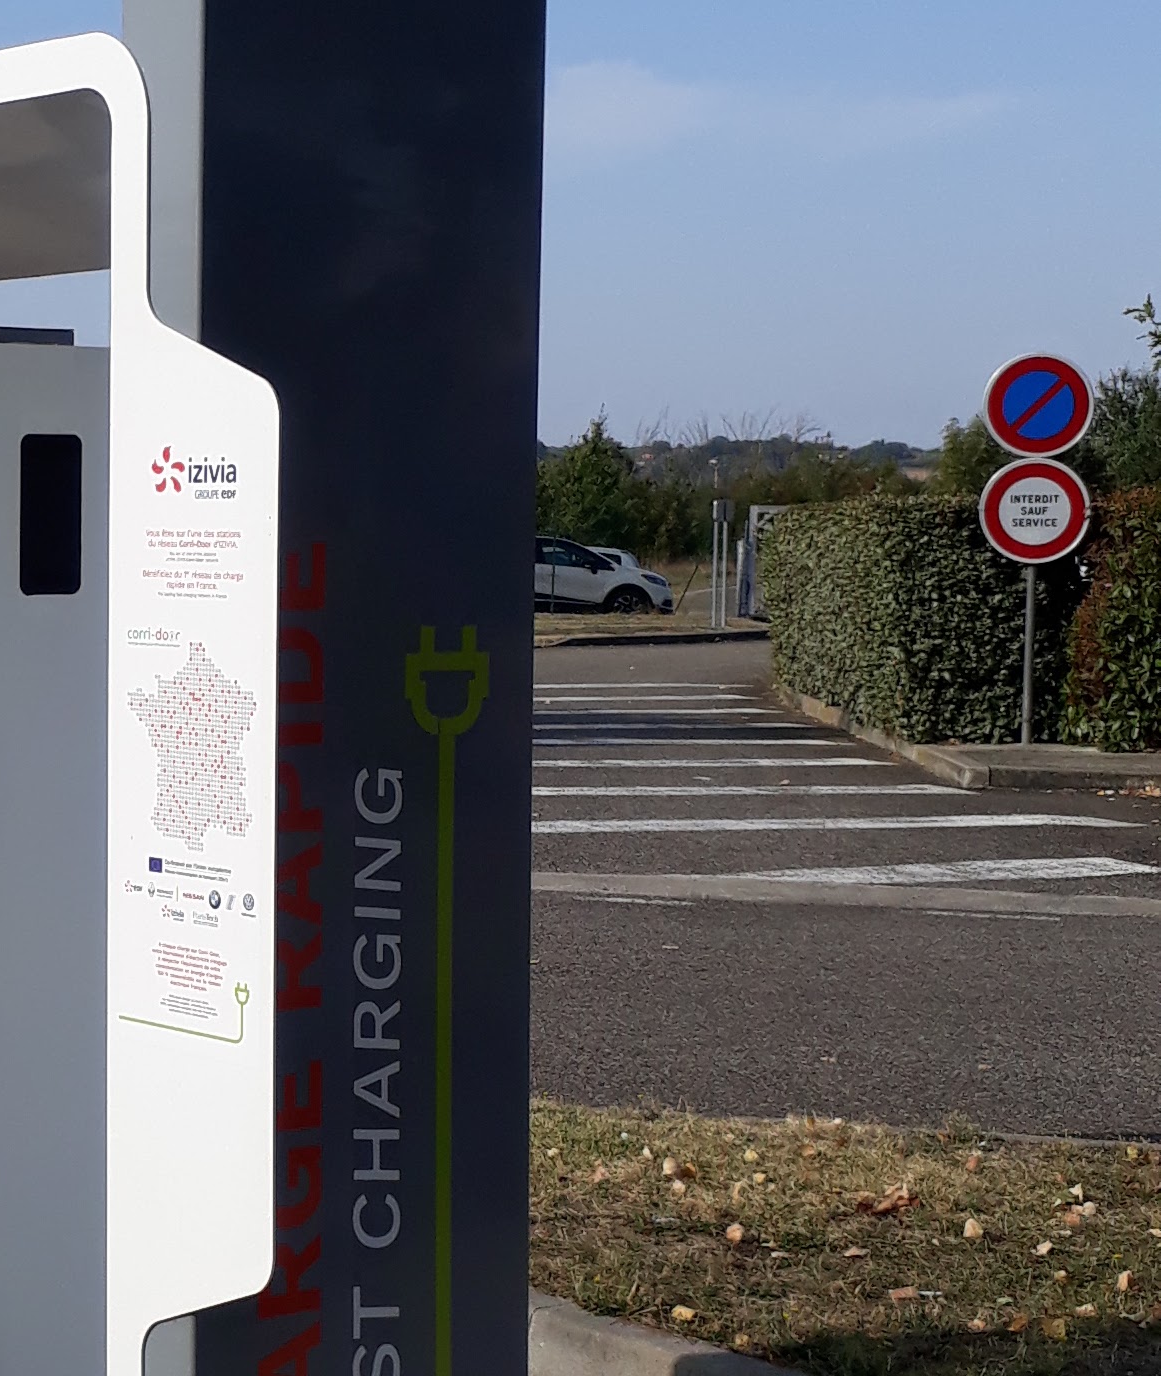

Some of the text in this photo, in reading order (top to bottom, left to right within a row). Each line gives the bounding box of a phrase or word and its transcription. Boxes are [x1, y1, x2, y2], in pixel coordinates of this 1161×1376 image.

[188, 456, 237, 484] izivia
[1009, 494, 1060, 504] INTERDIT
[1020, 506, 1049, 516] SAUF
[1011, 517, 1059, 528] SERVICE
[275, 541, 327, 1012] RAPIDE
[351, 766, 403, 1249] CHARGING
